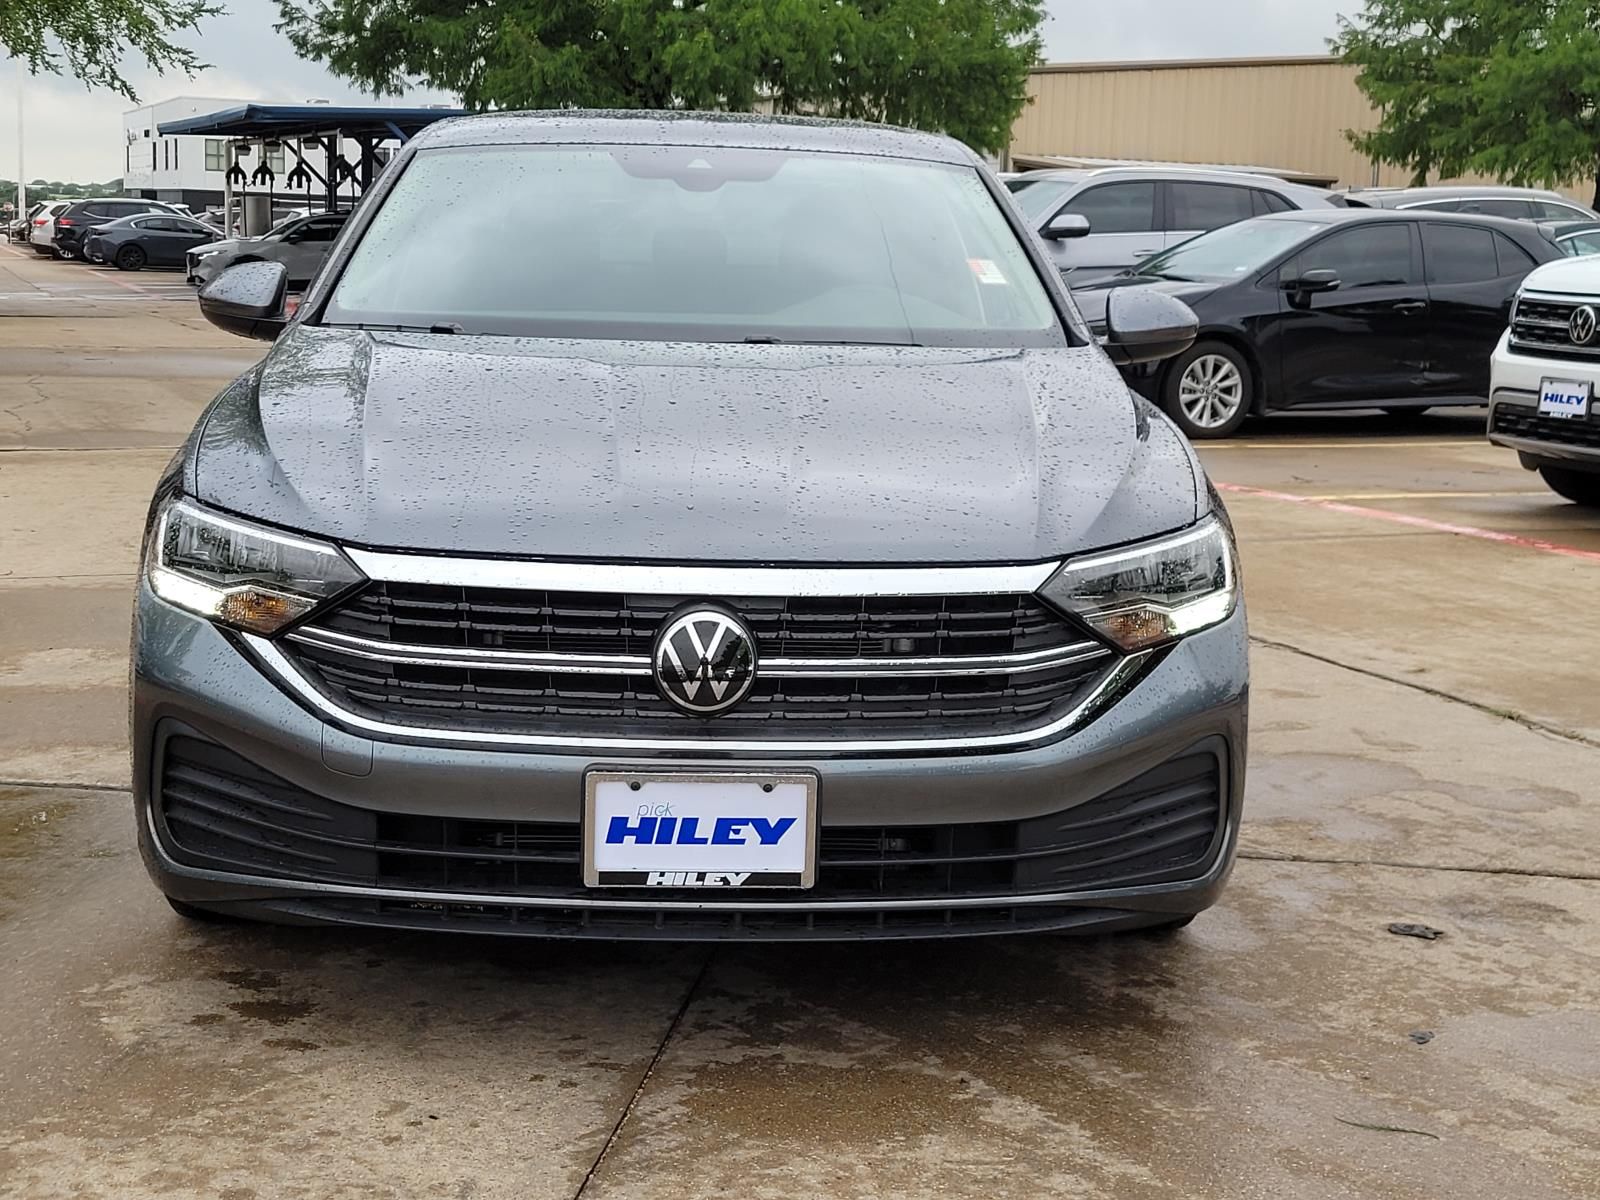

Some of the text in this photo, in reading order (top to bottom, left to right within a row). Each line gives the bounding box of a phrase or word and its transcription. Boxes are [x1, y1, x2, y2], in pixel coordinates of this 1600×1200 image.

[1543, 392, 1584, 405] HILEY
[658, 612, 753, 708] VW
[637, 802, 675, 817] pick
[605, 816, 797, 844] HILEY
[646, 871, 751, 886] HILEY
